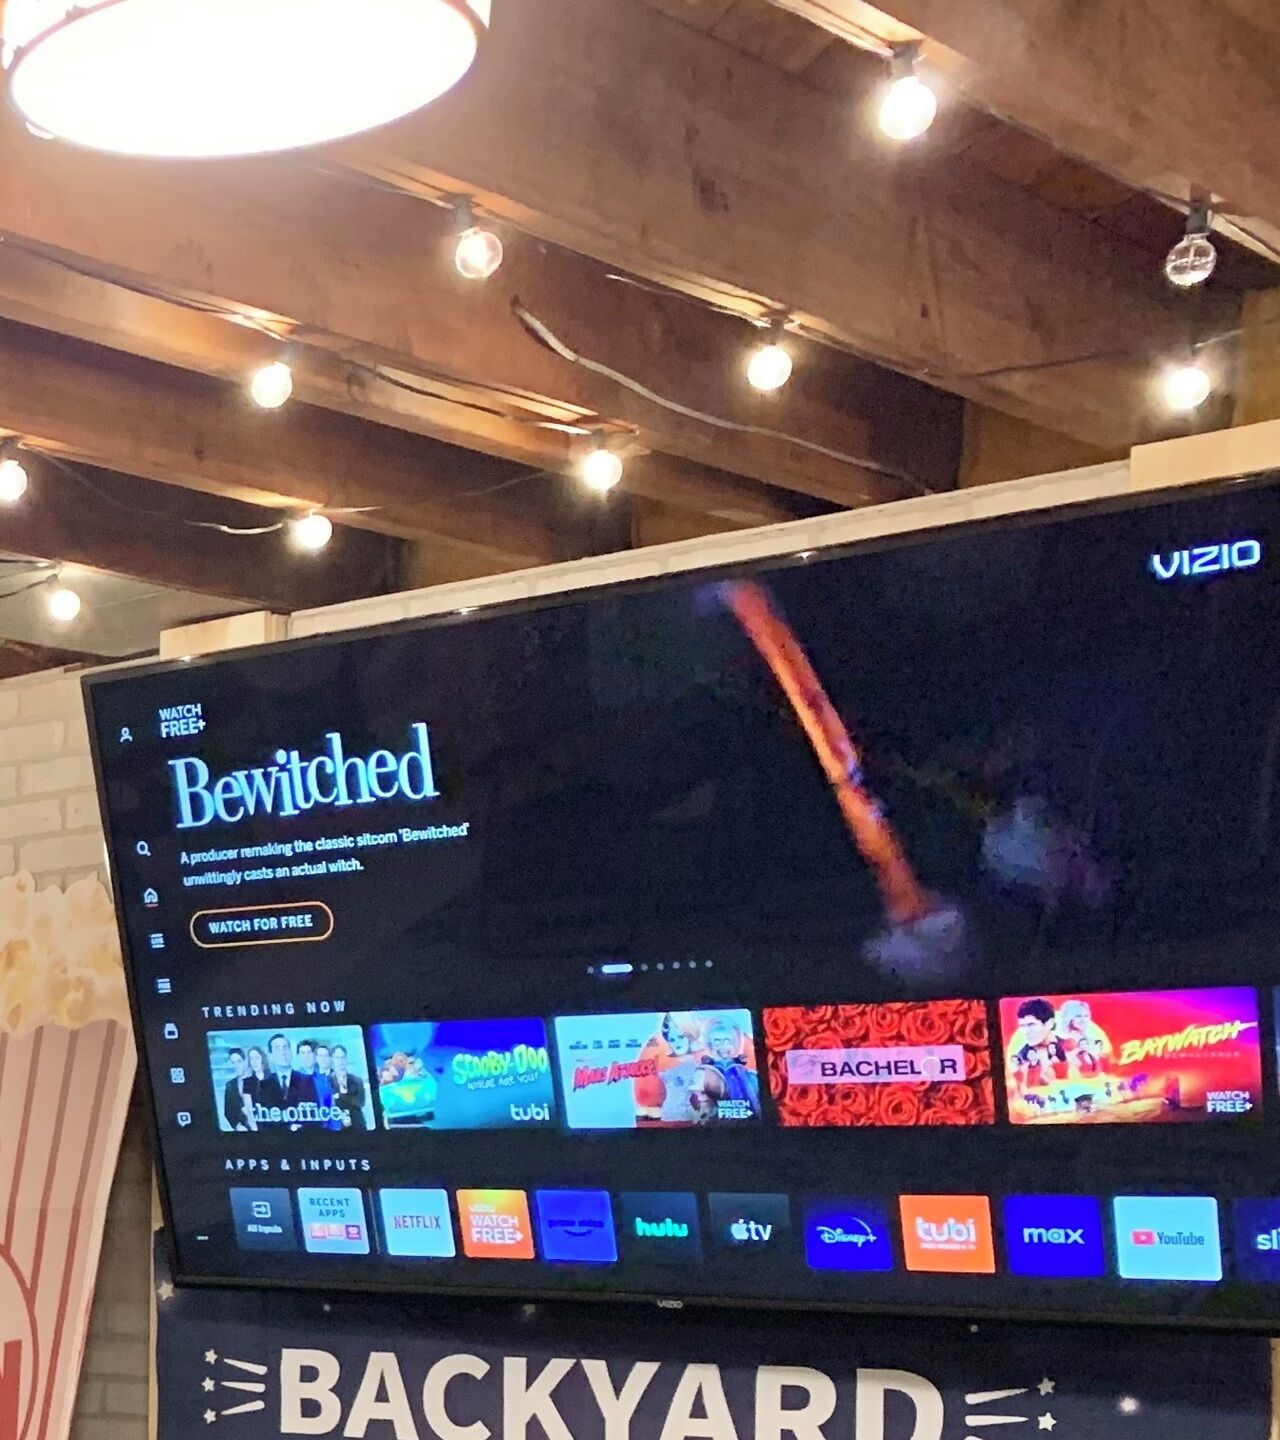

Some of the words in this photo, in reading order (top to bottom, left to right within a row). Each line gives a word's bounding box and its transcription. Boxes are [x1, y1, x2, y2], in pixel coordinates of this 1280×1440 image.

[1152, 539, 1261, 578] VIZIO
[158, 703, 202, 720] WATCH
[160, 717, 207, 738] FREE+
[168, 721, 441, 829] Bewitched
[180, 851, 190, 864] A
[190, 848, 238, 866] producer
[240, 842, 293, 857] remaking
[294, 839, 313, 853] the
[315, 835, 355, 850] classic
[357, 832, 398, 847] sitcom
[183, 869, 242, 887] unwittingly
[244, 867, 274, 881] casts
[275, 866, 290, 878] an
[291, 860, 327, 876] actual
[328, 858, 365, 873] witch.
[208, 919, 251, 934] WATCH
[253, 917, 278, 931] FOR
[280, 914, 313, 929] FREE
[202, 1002, 295, 1019] TRENDING
[306, 1000, 346, 1014] NOW
[1118, 1020, 1252, 1067] BAYWATCH
[717, 1099, 750, 1109] WATCH
[1206, 1090, 1250, 1101] WATCH
[251, 1102, 281, 1122] the
[286, 1101, 341, 1122] office
[510, 1103, 551, 1121] tubi
[225, 1158, 269, 1171] APPS
[280, 1158, 290, 1171] &
[301, 1158, 371, 1171] INPUTS
[309, 1197, 350, 1207] RECENT
[318, 1209, 346, 1218] APPS
[393, 1214, 441, 1230] NETFLIX
[470, 1214, 519, 1227] WATCH
[635, 1217, 688, 1237] hulu
[749, 1220, 773, 1241] tv
[914, 1216, 977, 1242] tubi
[1023, 1226, 1085, 1245] max
[1156, 1230, 1205, 1246] YouTube
